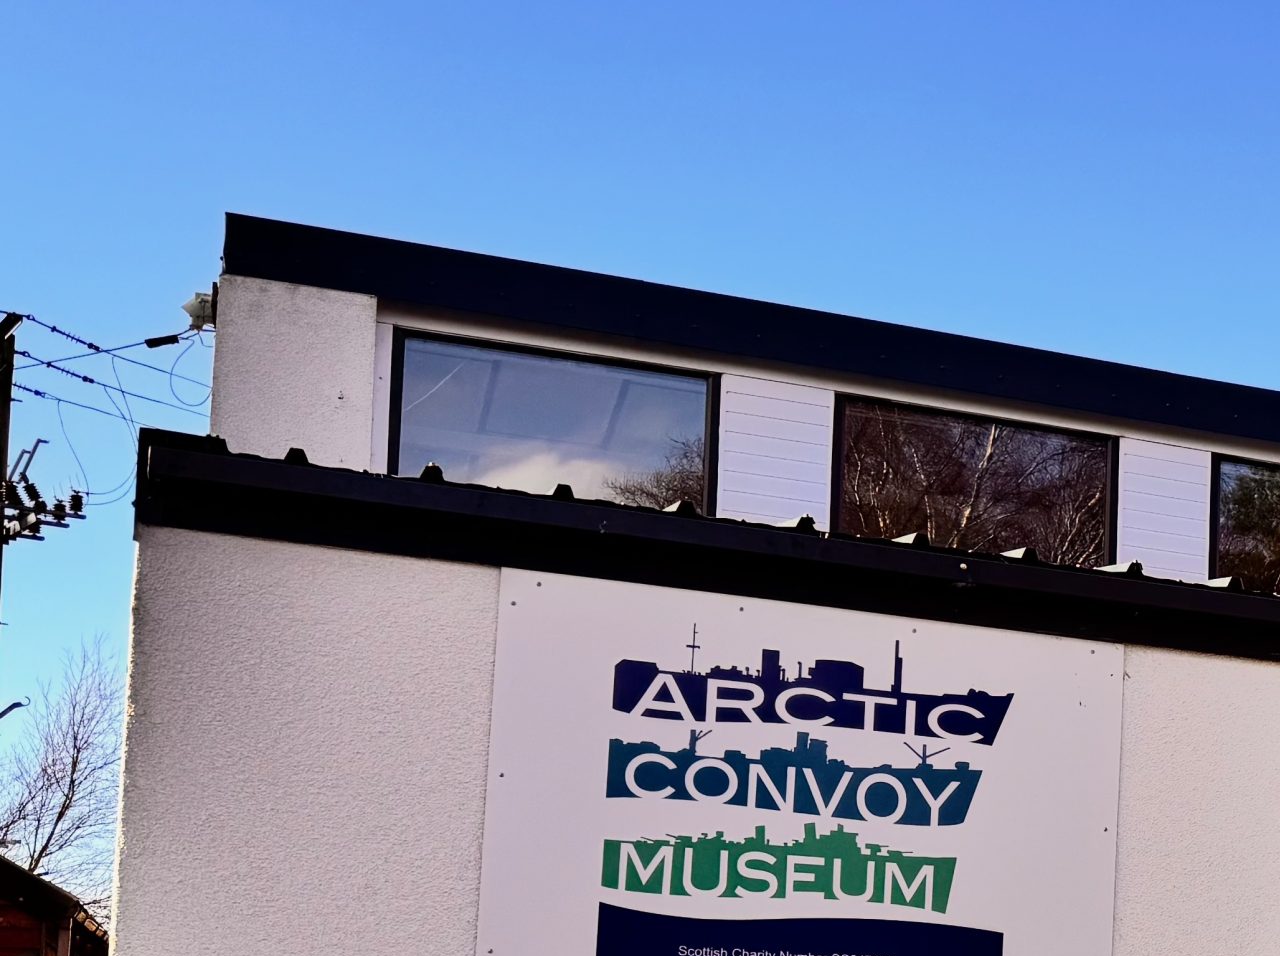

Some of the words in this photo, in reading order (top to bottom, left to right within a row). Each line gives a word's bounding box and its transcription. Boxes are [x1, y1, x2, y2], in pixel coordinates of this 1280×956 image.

[630, 672, 986, 742] ARCTIC
[624, 752, 961, 826] CONVOY
[618, 843, 935, 911] MUSEUM
